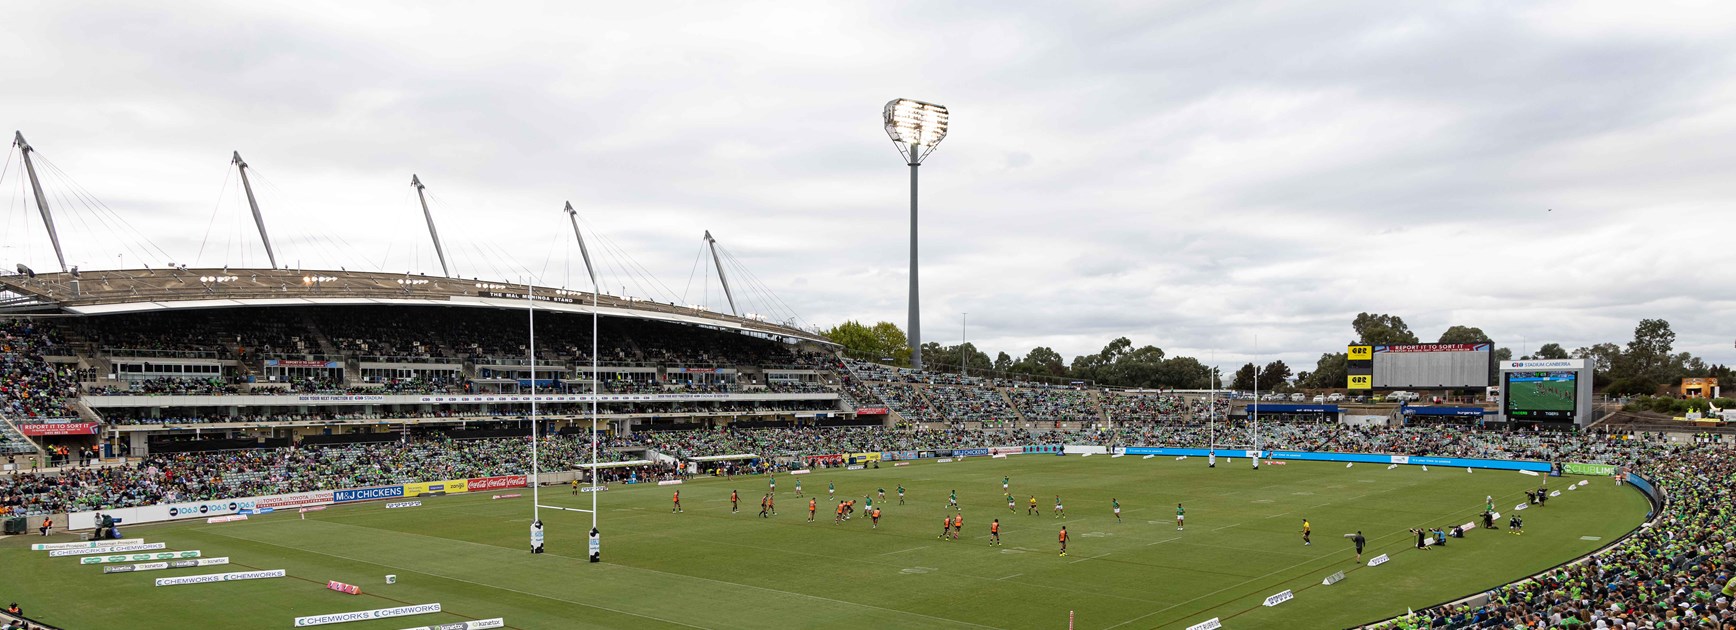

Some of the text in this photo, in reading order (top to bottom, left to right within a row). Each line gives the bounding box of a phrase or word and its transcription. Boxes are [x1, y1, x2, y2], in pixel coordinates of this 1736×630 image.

[336, 490, 356, 500] M&J
[357, 487, 402, 499] CHICKENS
[208, 504, 227, 512] 106.3
[237, 501, 255, 509] 106.3
[179, 507, 198, 515] 106.3
[116, 543, 163, 551] CHEMWORKS
[57, 548, 106, 556] CHEMWORKS
[230, 571, 283, 580] CHEMWORKS
[164, 575, 219, 585] CHEMWORKS
[381, 604, 440, 616] CHEMWORKS
[307, 612, 370, 625] CHEMWORKS
